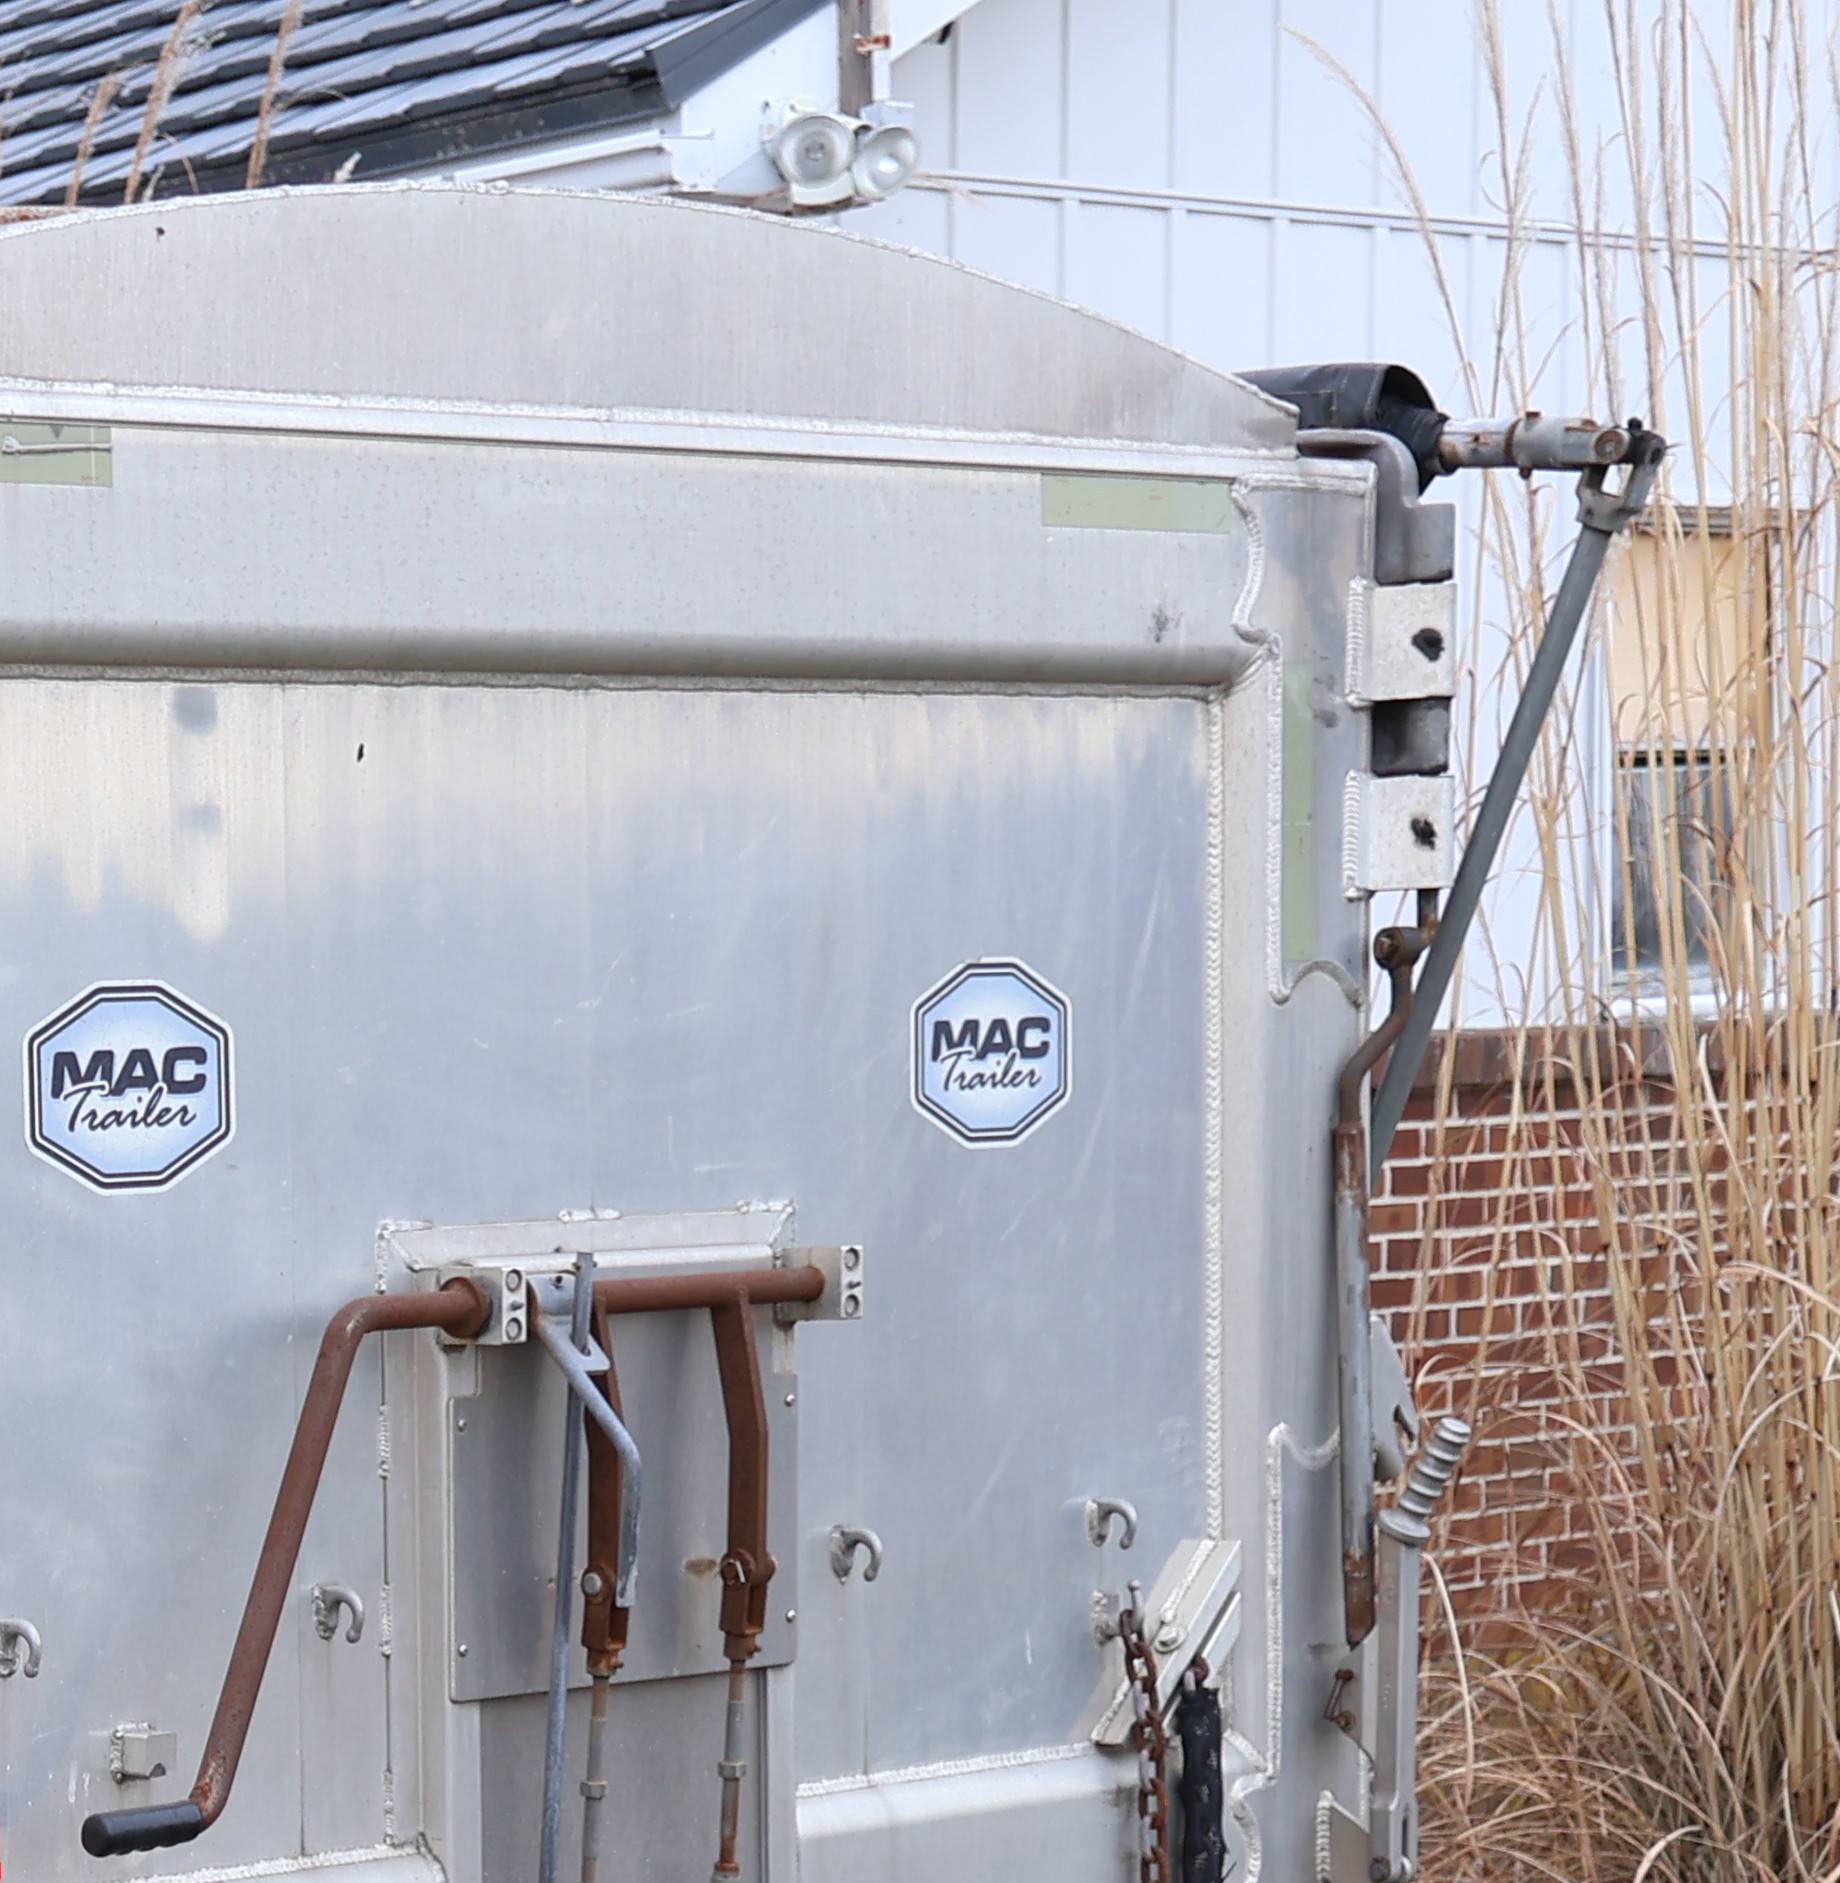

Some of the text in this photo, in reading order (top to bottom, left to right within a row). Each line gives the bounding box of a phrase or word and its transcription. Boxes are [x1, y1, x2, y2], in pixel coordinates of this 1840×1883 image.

[932, 1016, 1050, 1063] MAC
[51, 1045, 208, 1099] MAC
[941, 1049, 1042, 1092] Trailer
[63, 1084, 197, 1133] Trailer
